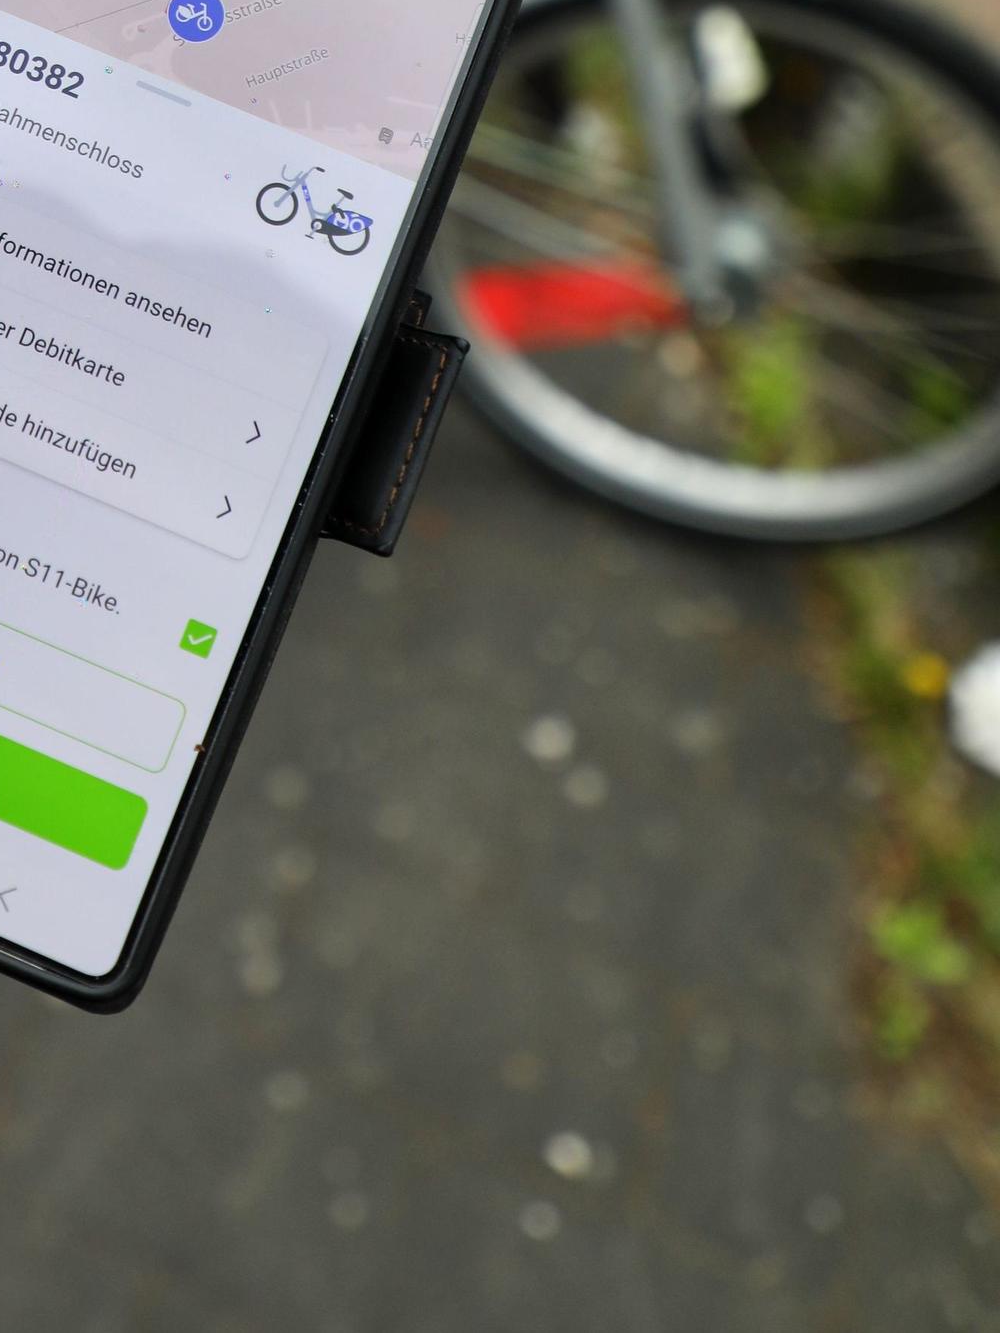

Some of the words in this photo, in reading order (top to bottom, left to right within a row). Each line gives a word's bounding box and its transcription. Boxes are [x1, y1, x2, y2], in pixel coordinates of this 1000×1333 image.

[245, 47, 330, 88] Hauptstraße
[124, 290, 212, 338] ansehen
[19, 327, 126, 387] Debitkarte
[21, 414, 137, 479] hinzufügen
[24, 558, 121, 615] S11-Bike.
